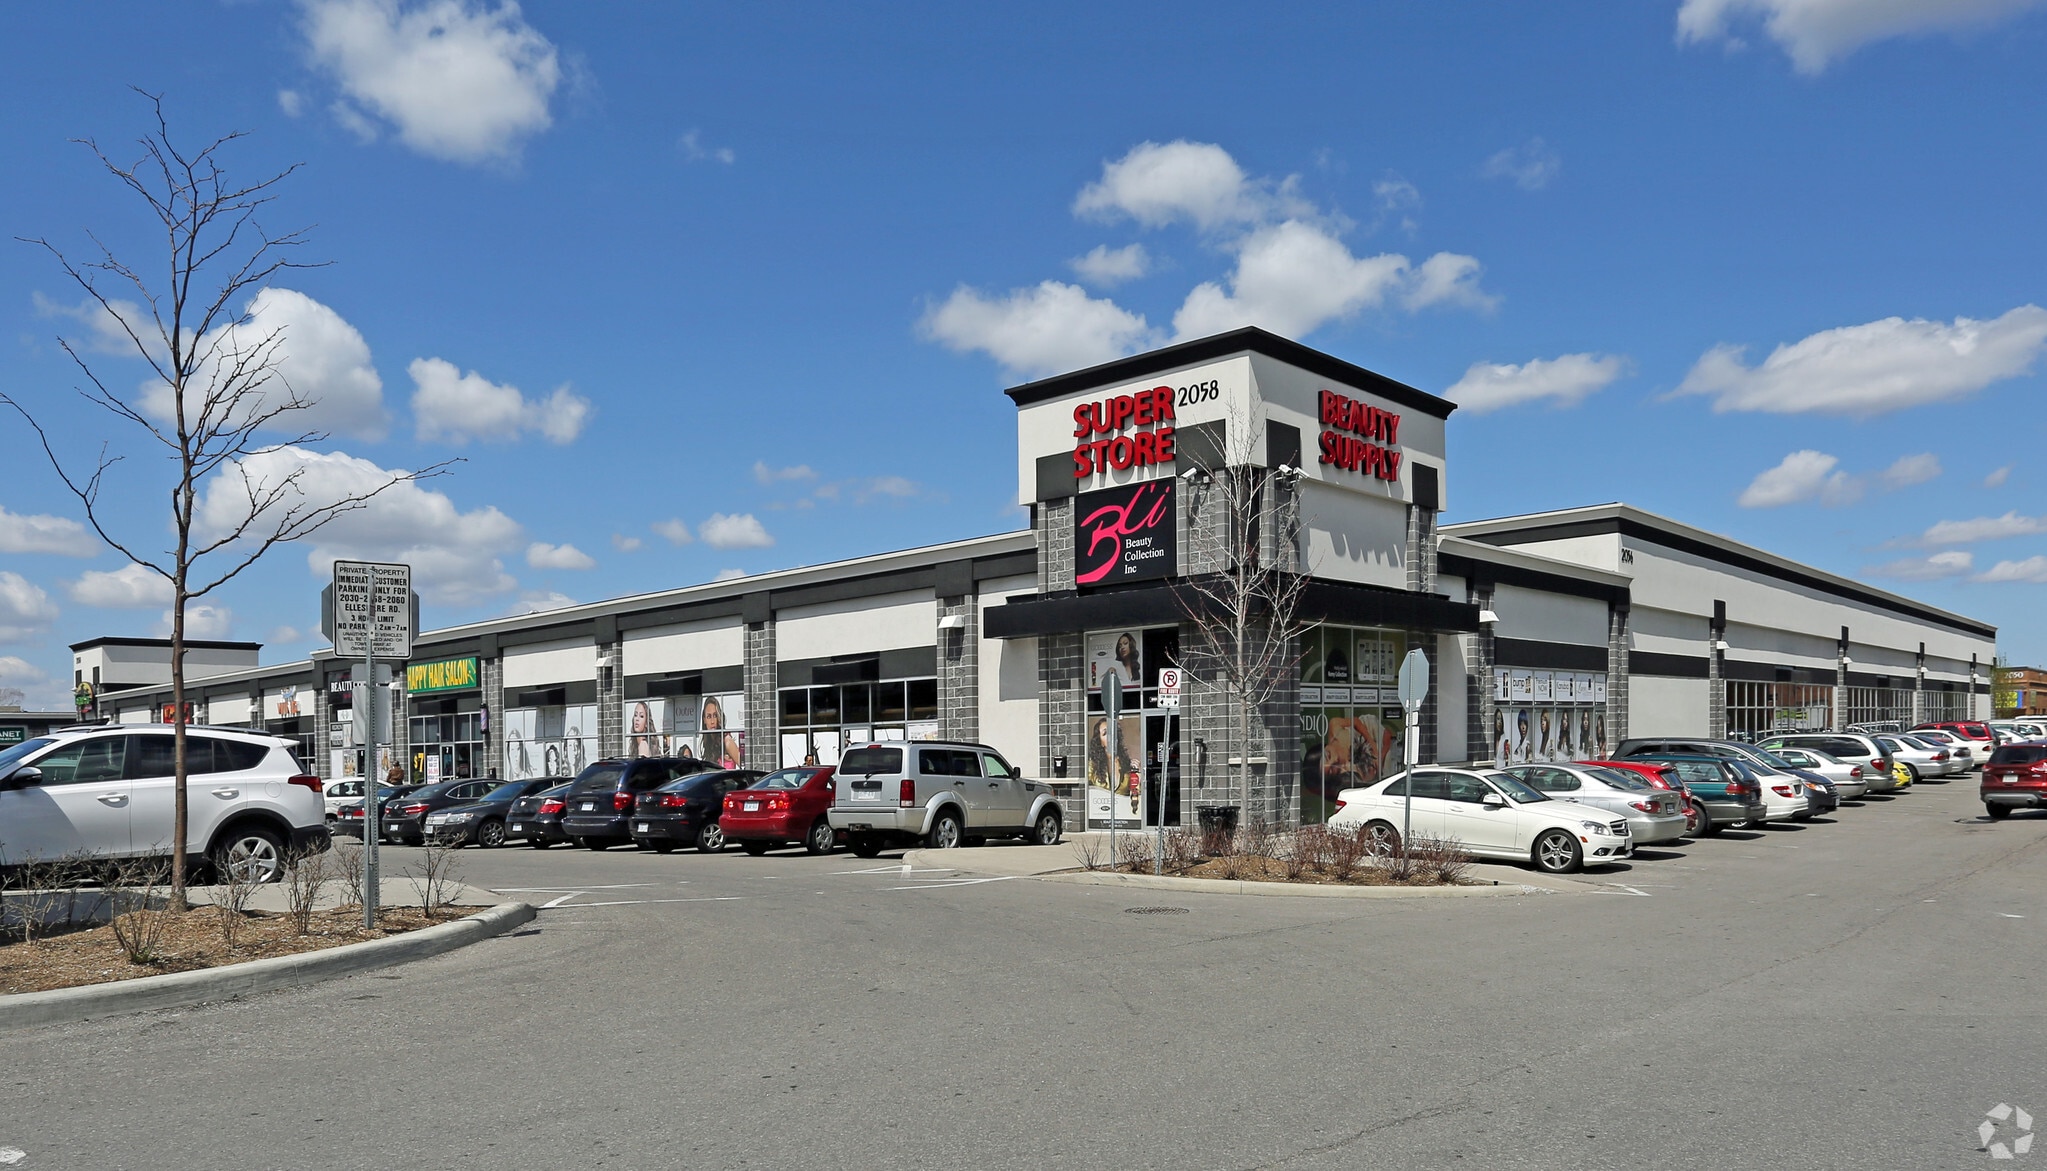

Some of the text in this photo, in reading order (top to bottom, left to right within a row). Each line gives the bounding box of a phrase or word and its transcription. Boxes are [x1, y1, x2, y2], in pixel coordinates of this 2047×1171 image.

[1178, 380, 1219, 407] 2058
[1073, 386, 1175, 438] SUPER
[1318, 390, 1400, 444] BEAUTY
[1073, 427, 1175, 478] STORE
[1318, 430, 1400, 481] SUPPLY
[1125, 537, 1152, 549] Beauty
[1124, 548, 1165, 561] Collection
[373, 568, 405, 576] ROPERTY
[1124, 565, 1137, 574] Inc
[338, 575, 369, 584] IMMEDIAT
[393, 587, 407, 595] FOR
[345, 603, 401, 613] ELLESRE RD.
[349, 622, 377, 631] PARK
[407, 660, 468, 690] HAPPY HAIR SALON
[413, 753, 424, 772] $7
